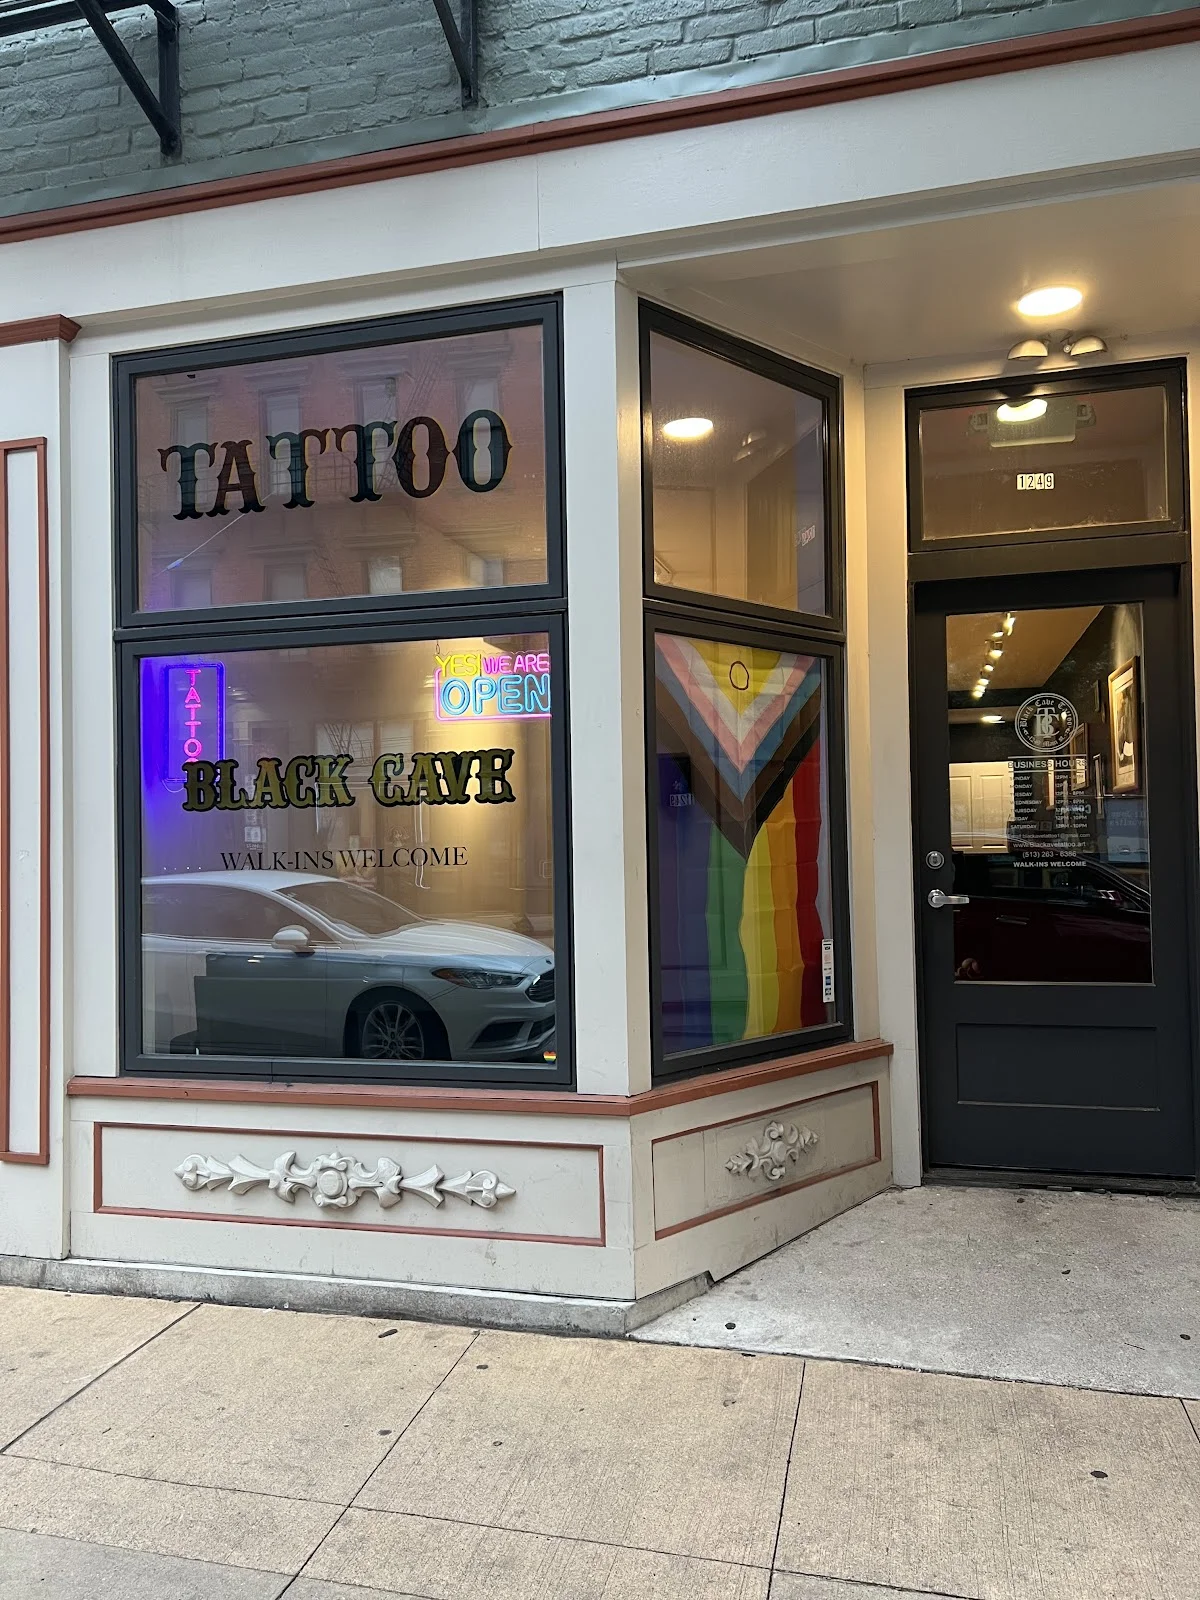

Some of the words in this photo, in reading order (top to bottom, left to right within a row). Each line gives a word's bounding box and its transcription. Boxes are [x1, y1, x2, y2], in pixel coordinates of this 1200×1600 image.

[157, 409, 512, 520] TATTOO
[1018, 474, 1053, 489] 1249
[483, 656, 512, 674] WE
[514, 653, 550, 674] ARE
[440, 674, 551, 715] OPEN
[1034, 698, 1055, 707] Cave
[183, 669, 203, 762] TATTO
[1007, 759, 1053, 769] BUSINESS
[1055, 758, 1087, 768] HOURS
[182, 753, 356, 811] BLACK
[372, 748, 516, 808] CAVE
[220, 850, 334, 870] WALK-INS
[338, 846, 469, 869] WELCOME
[1022, 851, 1040, 859] (513)
